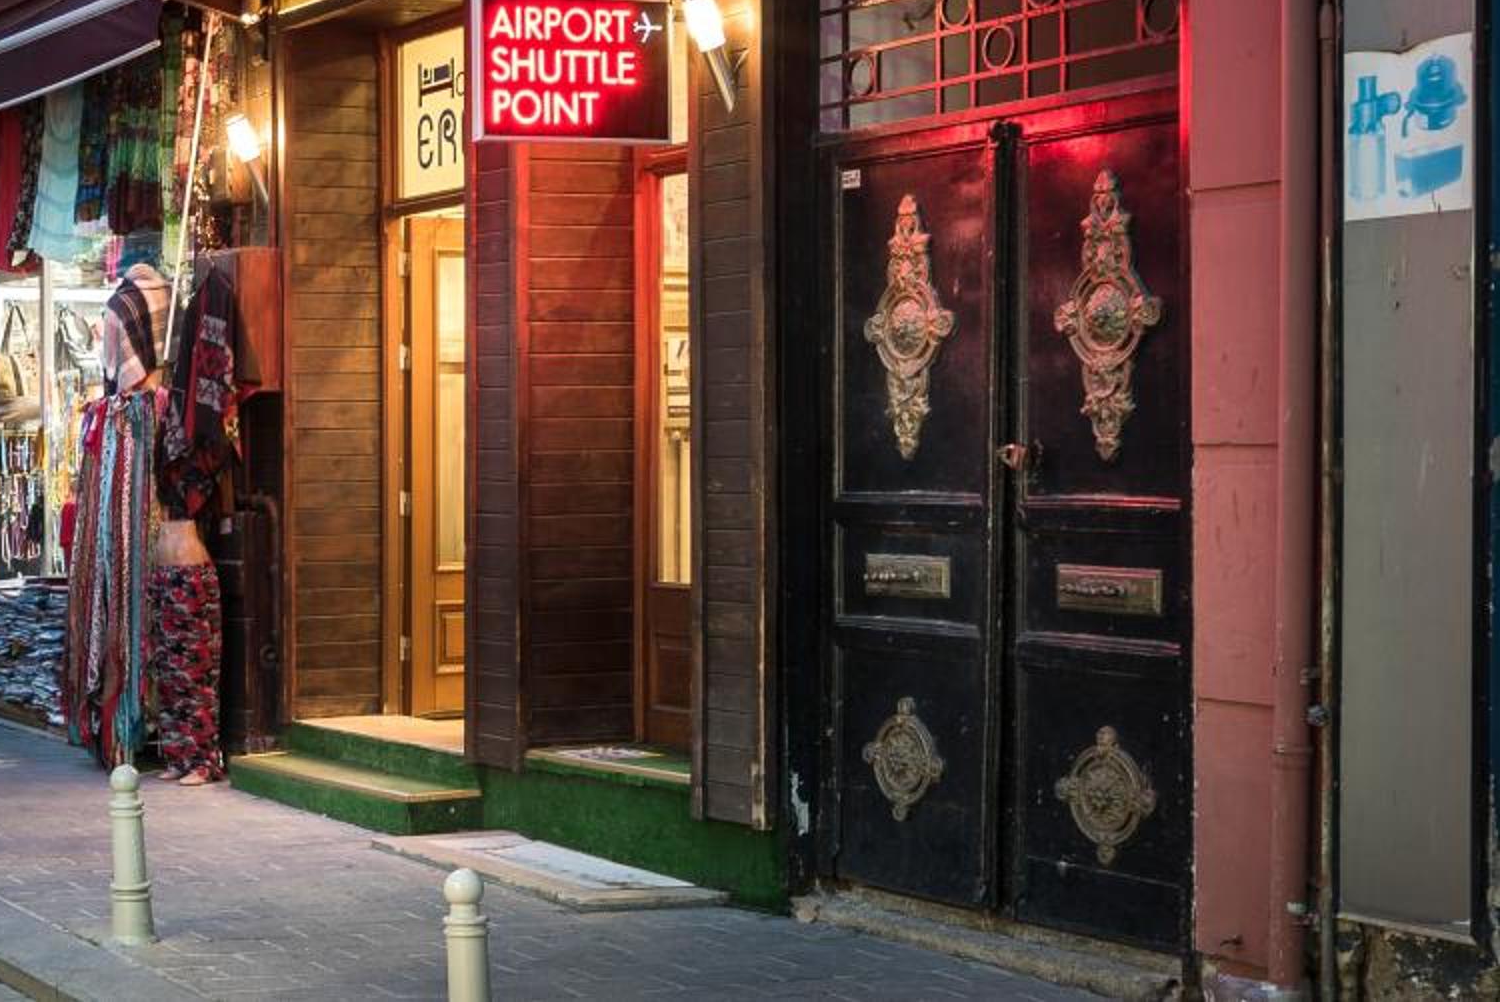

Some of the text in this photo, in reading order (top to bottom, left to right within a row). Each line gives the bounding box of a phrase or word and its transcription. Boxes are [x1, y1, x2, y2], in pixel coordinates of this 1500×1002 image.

[489, 6, 631, 43] AIRPORT
[491, 46, 636, 85] SHUTTLE
[492, 89, 600, 125] POINT
